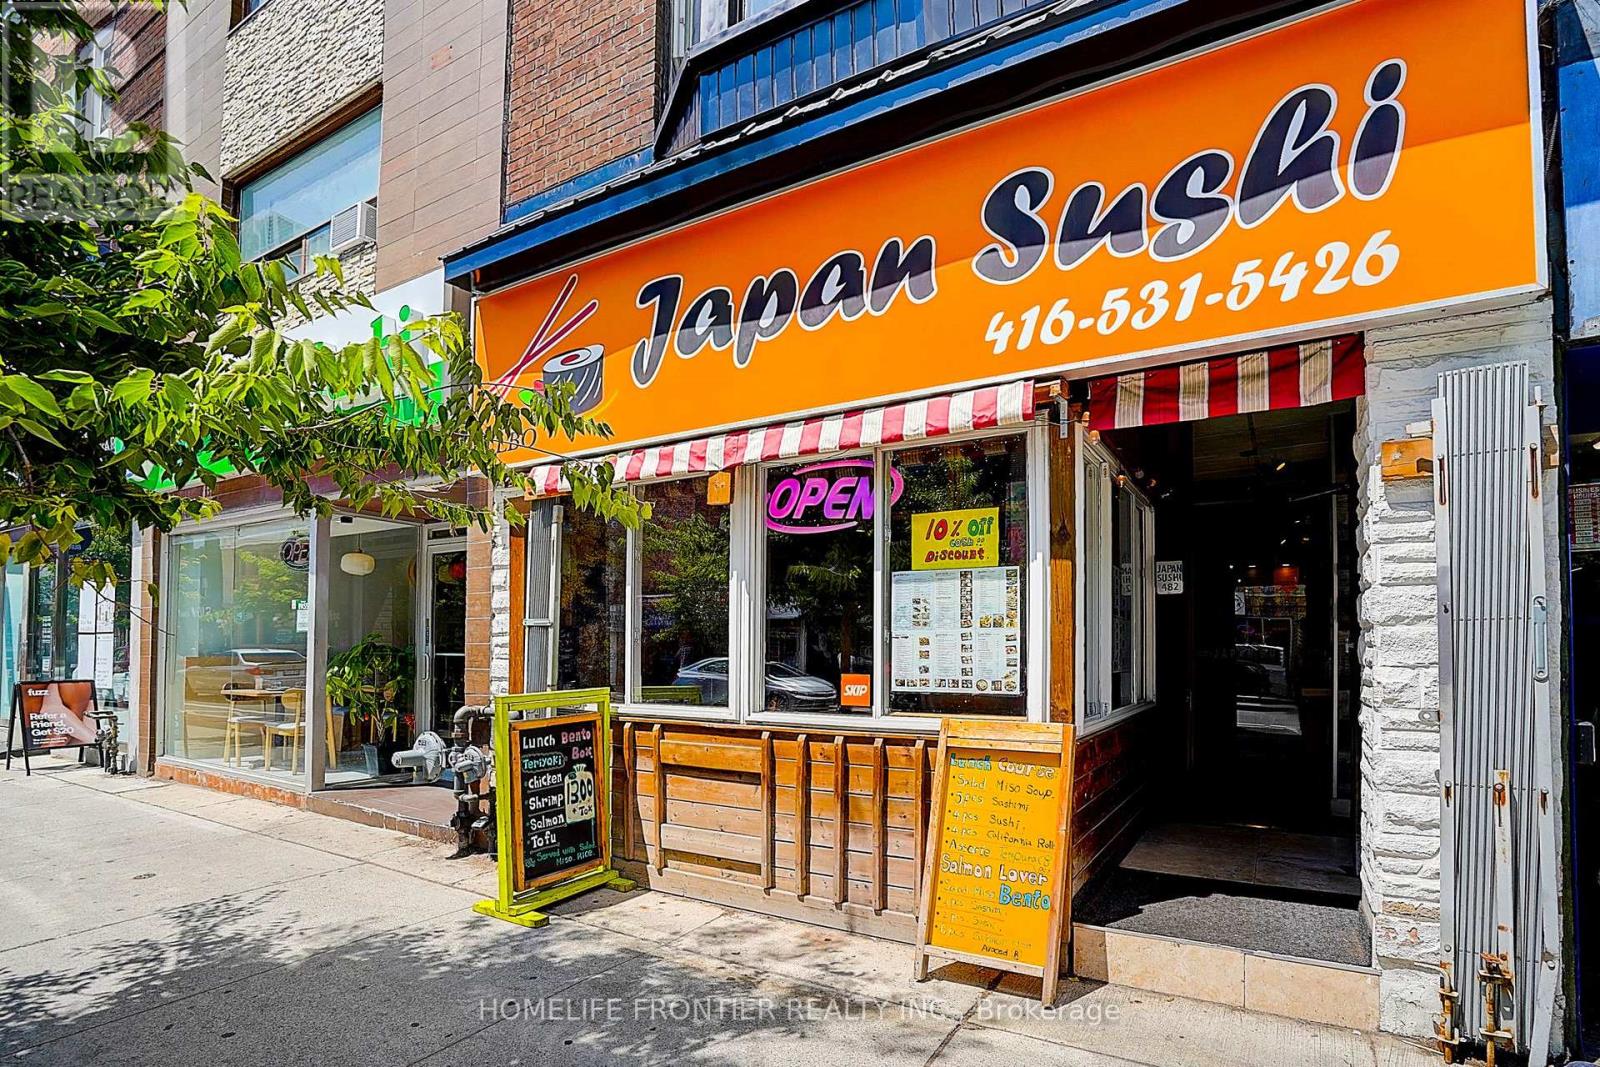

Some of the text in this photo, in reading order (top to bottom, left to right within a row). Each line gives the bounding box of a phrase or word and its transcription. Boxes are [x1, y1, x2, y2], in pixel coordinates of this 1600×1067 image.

[630, 234, 938, 389] Japan
[971, 58, 1406, 284] Sushi
[984, 230, 1401, 355] 416-531-5426
[768, 476, 875, 519] OPEN
[925, 518, 964, 540] 10%
[283, 541, 310, 563] OPE
[1157, 564, 1183, 574] JAPAN
[1157, 573, 1182, 582] SUSHI
[1161, 583, 1179, 591] 482
[27, 688, 49, 696] fuzz
[843, 684, 868, 696] SKIP
[30, 712, 57, 720] Refer
[53, 726, 74, 735] $20
[522, 728, 591, 750] Lunch Bento
[949, 753, 992, 771] Lunch
[529, 794, 564, 810] Shrimp
[530, 814, 565, 830] Salmon
[531, 830, 557, 848] Tofu
[941, 852, 1048, 885] Salmon Lover
[999, 883, 1051, 911] Bento
